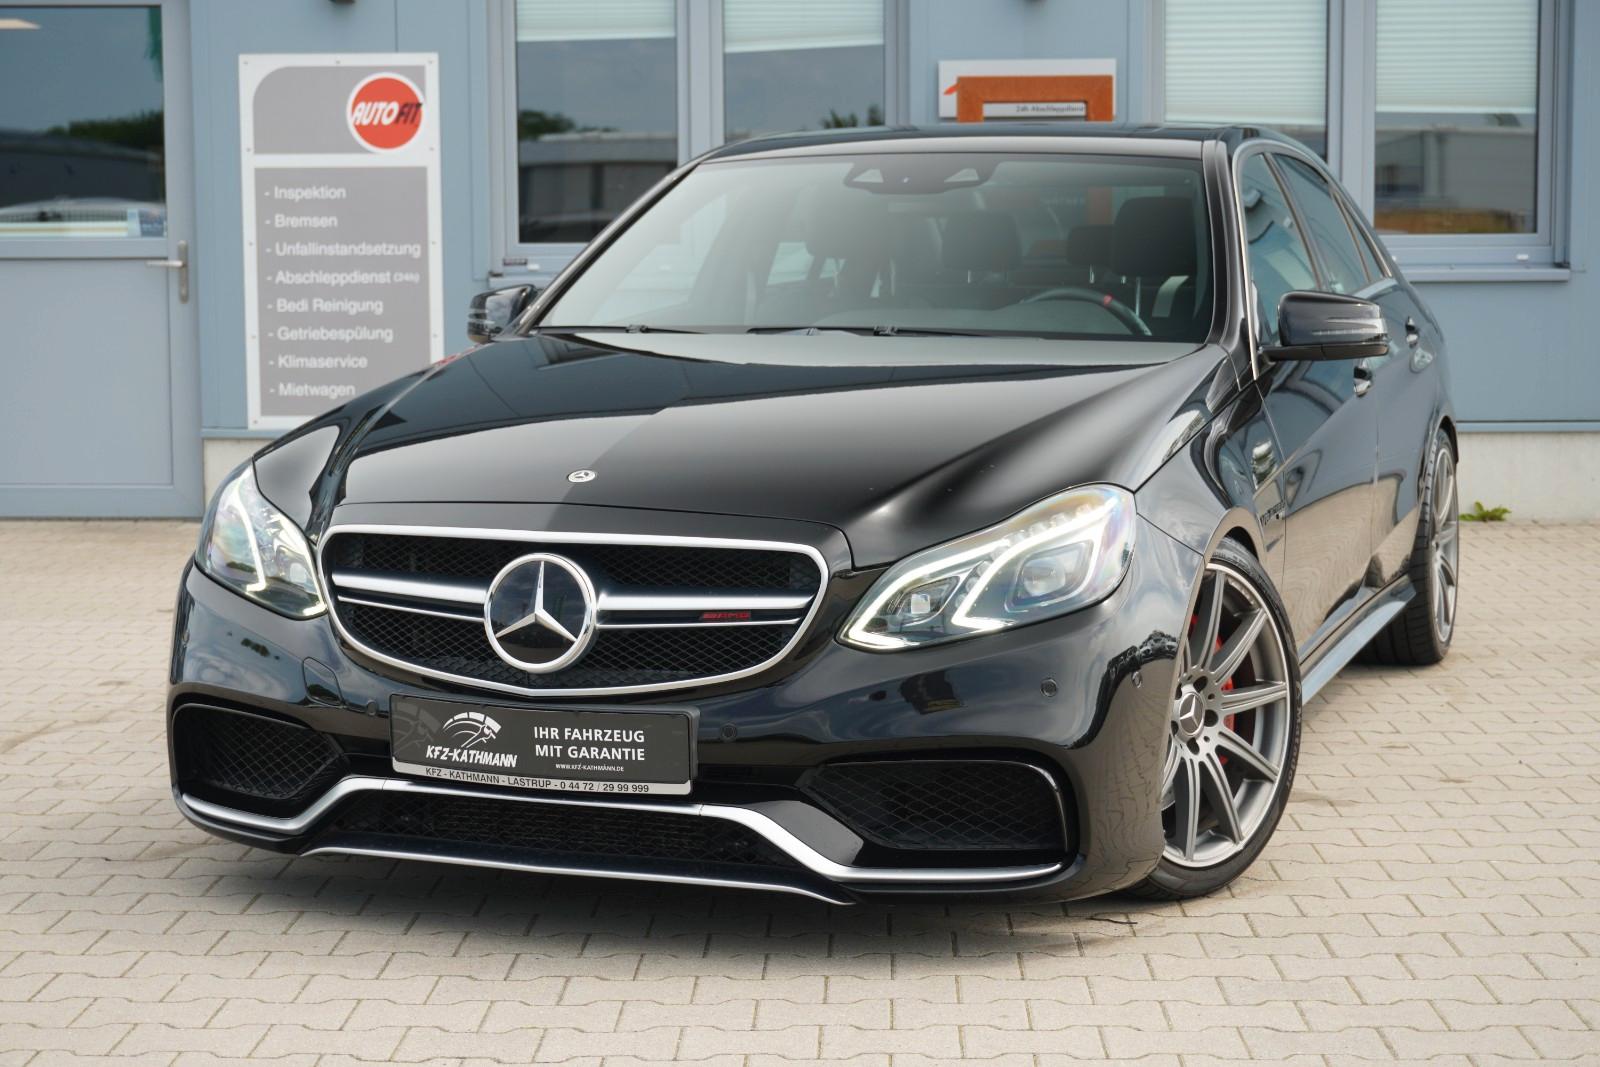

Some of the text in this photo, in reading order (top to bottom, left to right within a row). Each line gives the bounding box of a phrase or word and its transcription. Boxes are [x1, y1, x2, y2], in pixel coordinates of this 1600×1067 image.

[274, 185, 347, 203] Inspektion
[275, 213, 338, 228] Bremsen
[275, 241, 422, 259] Unfallinstandsetzung
[275, 270, 391, 287] Abschleppdienst
[276, 298, 384, 315] Bedi Reinigung
[277, 326, 394, 343] Getriebespülung
[278, 354, 368, 369] Klimaservice
[279, 382, 356, 399] Mietwagen
[534, 726, 645, 743] IHR FAHRZEUG
[425, 744, 518, 768] KFZ-KATHMANN
[535, 744, 646, 761] MIT GARANTIE
[425, 767, 442, 777] KFZ
[449, 771, 500, 784] KATHMANN
[508, 777, 552, 788] LASTRUP
